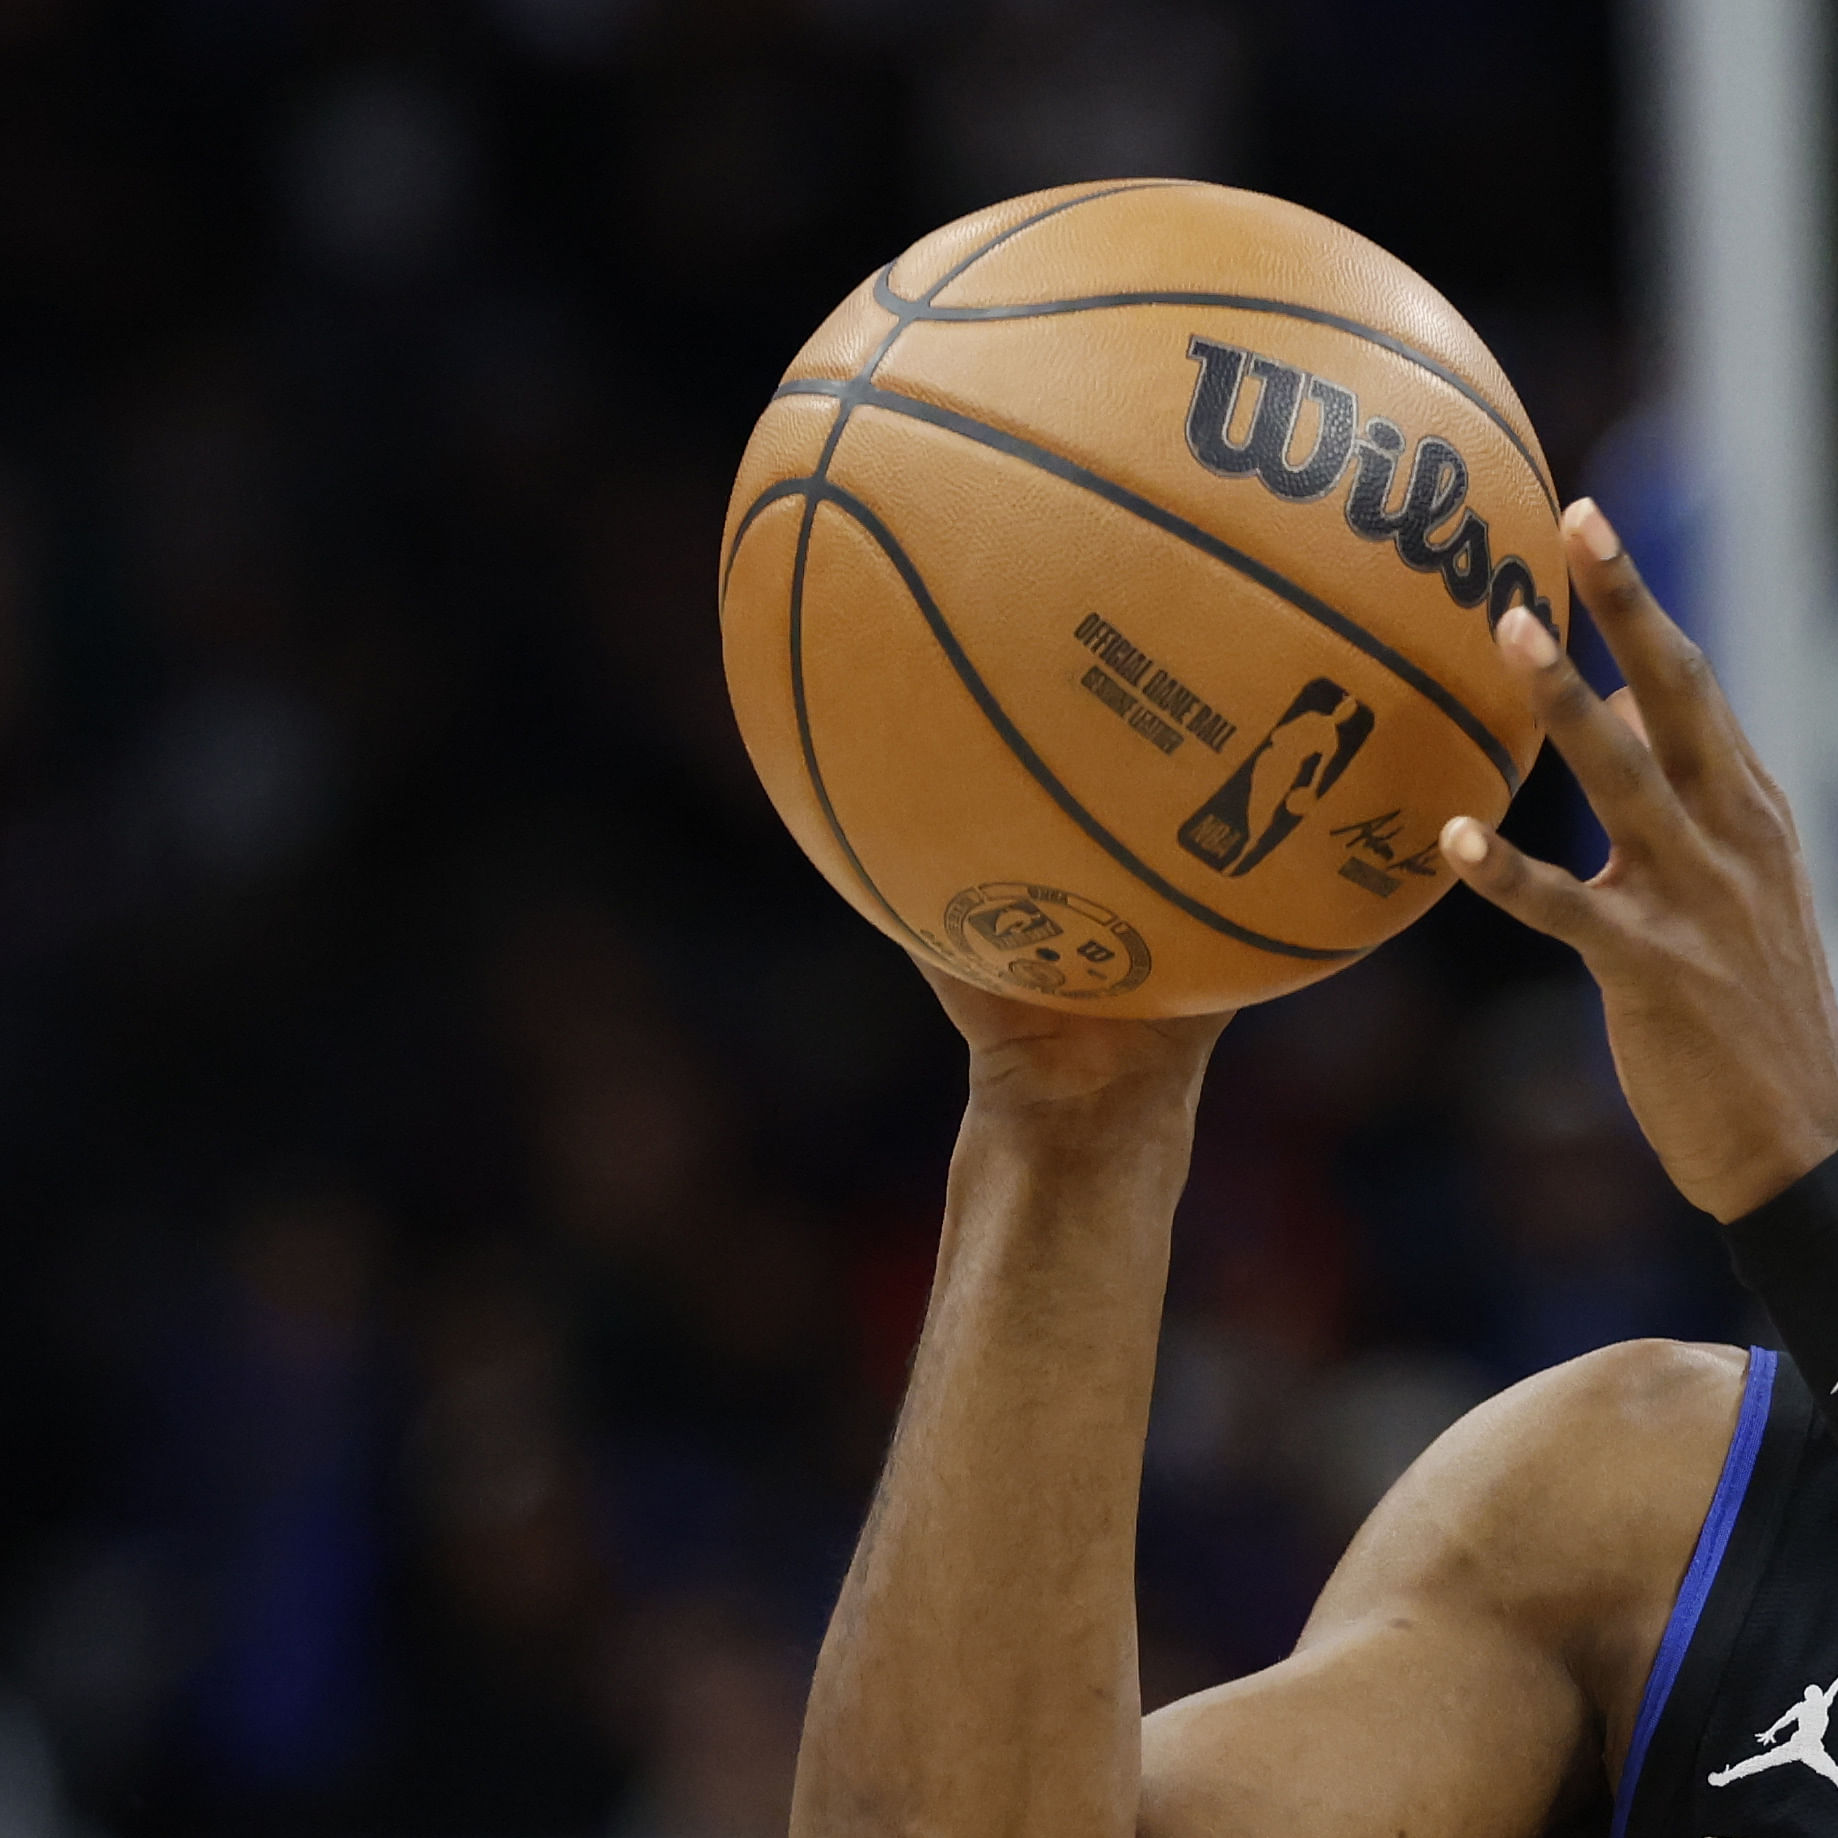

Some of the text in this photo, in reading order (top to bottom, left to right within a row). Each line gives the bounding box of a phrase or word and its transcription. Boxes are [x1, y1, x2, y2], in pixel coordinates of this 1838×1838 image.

[1185, 334, 1562, 646] Wilso
[1073, 611, 1154, 688] OFFICIAL
[1142, 669, 1200, 726] GAME
[1185, 702, 1238, 754] BALL
